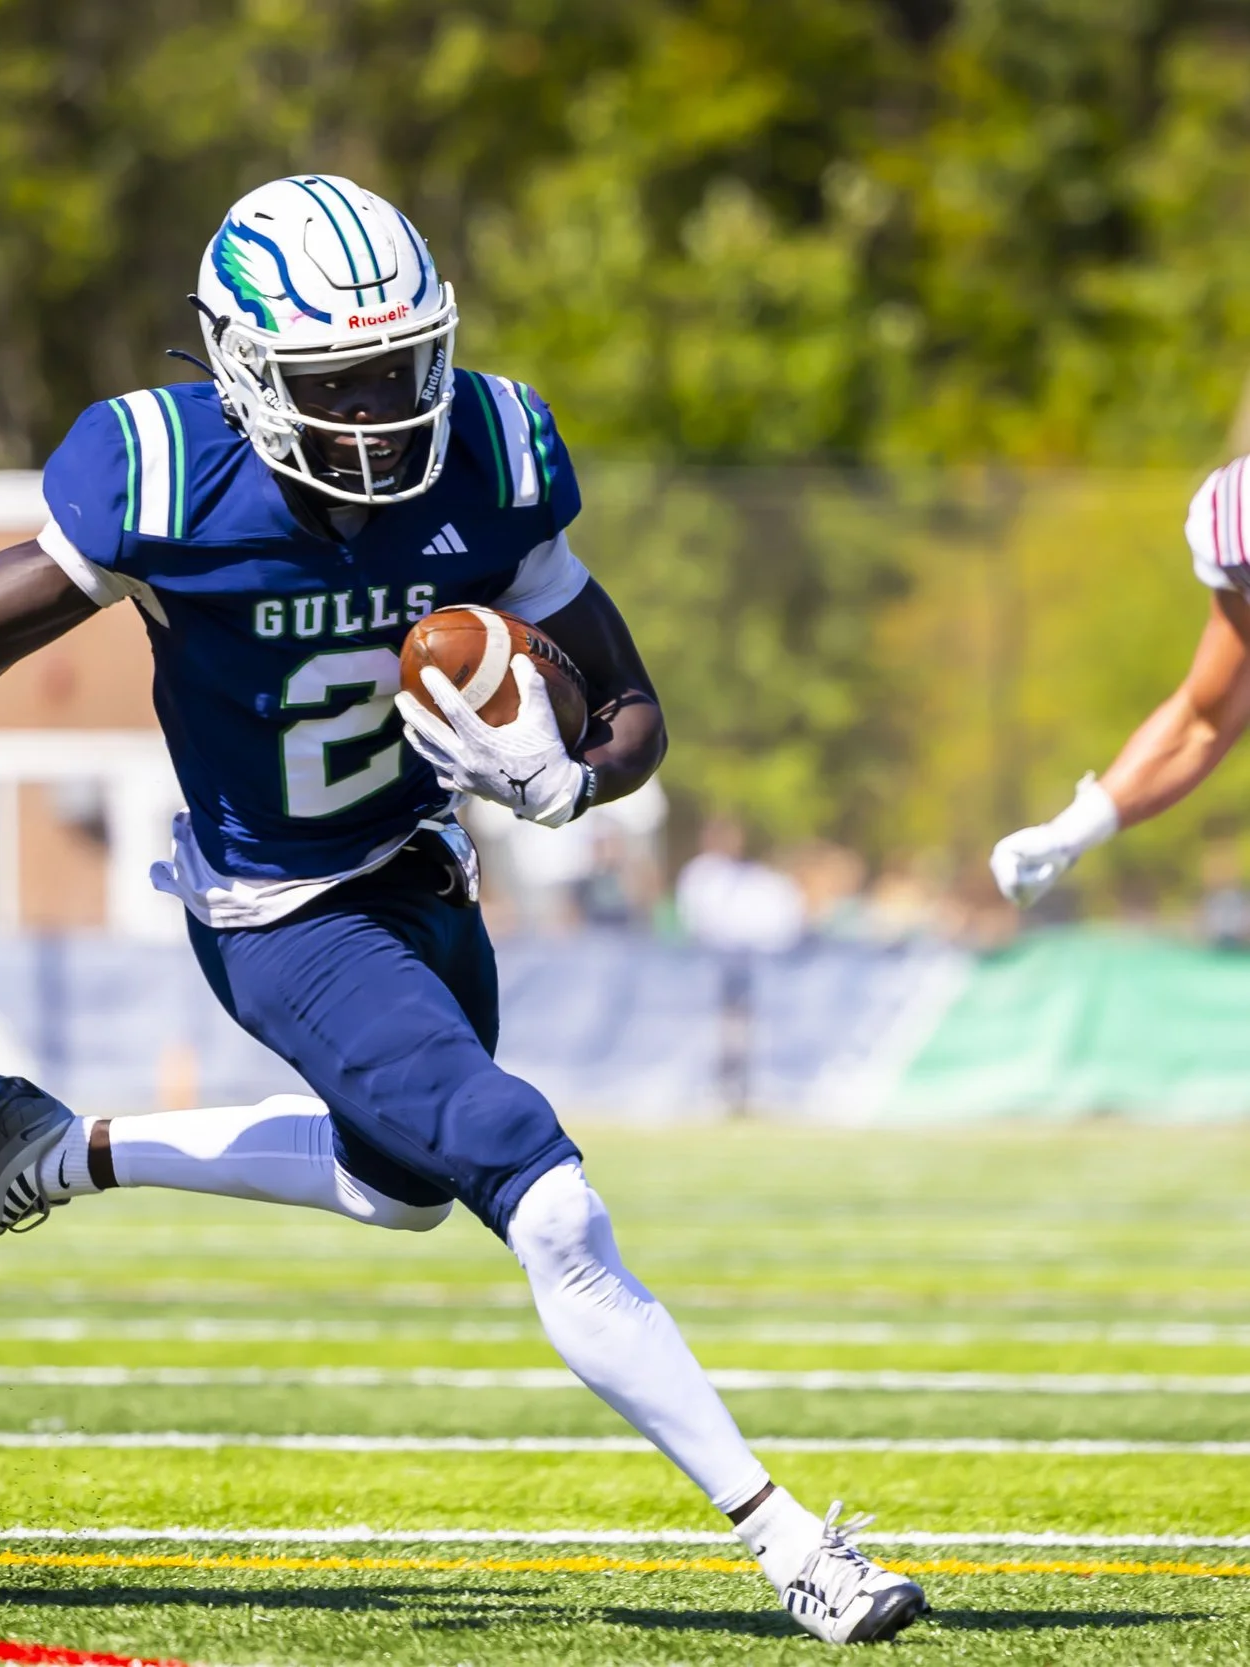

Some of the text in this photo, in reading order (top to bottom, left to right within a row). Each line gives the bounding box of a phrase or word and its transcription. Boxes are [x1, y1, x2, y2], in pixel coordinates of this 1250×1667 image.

[421, 348, 445, 401] Riddell
[255, 582, 437, 638] GULLS
[281, 645, 404, 819] 2
